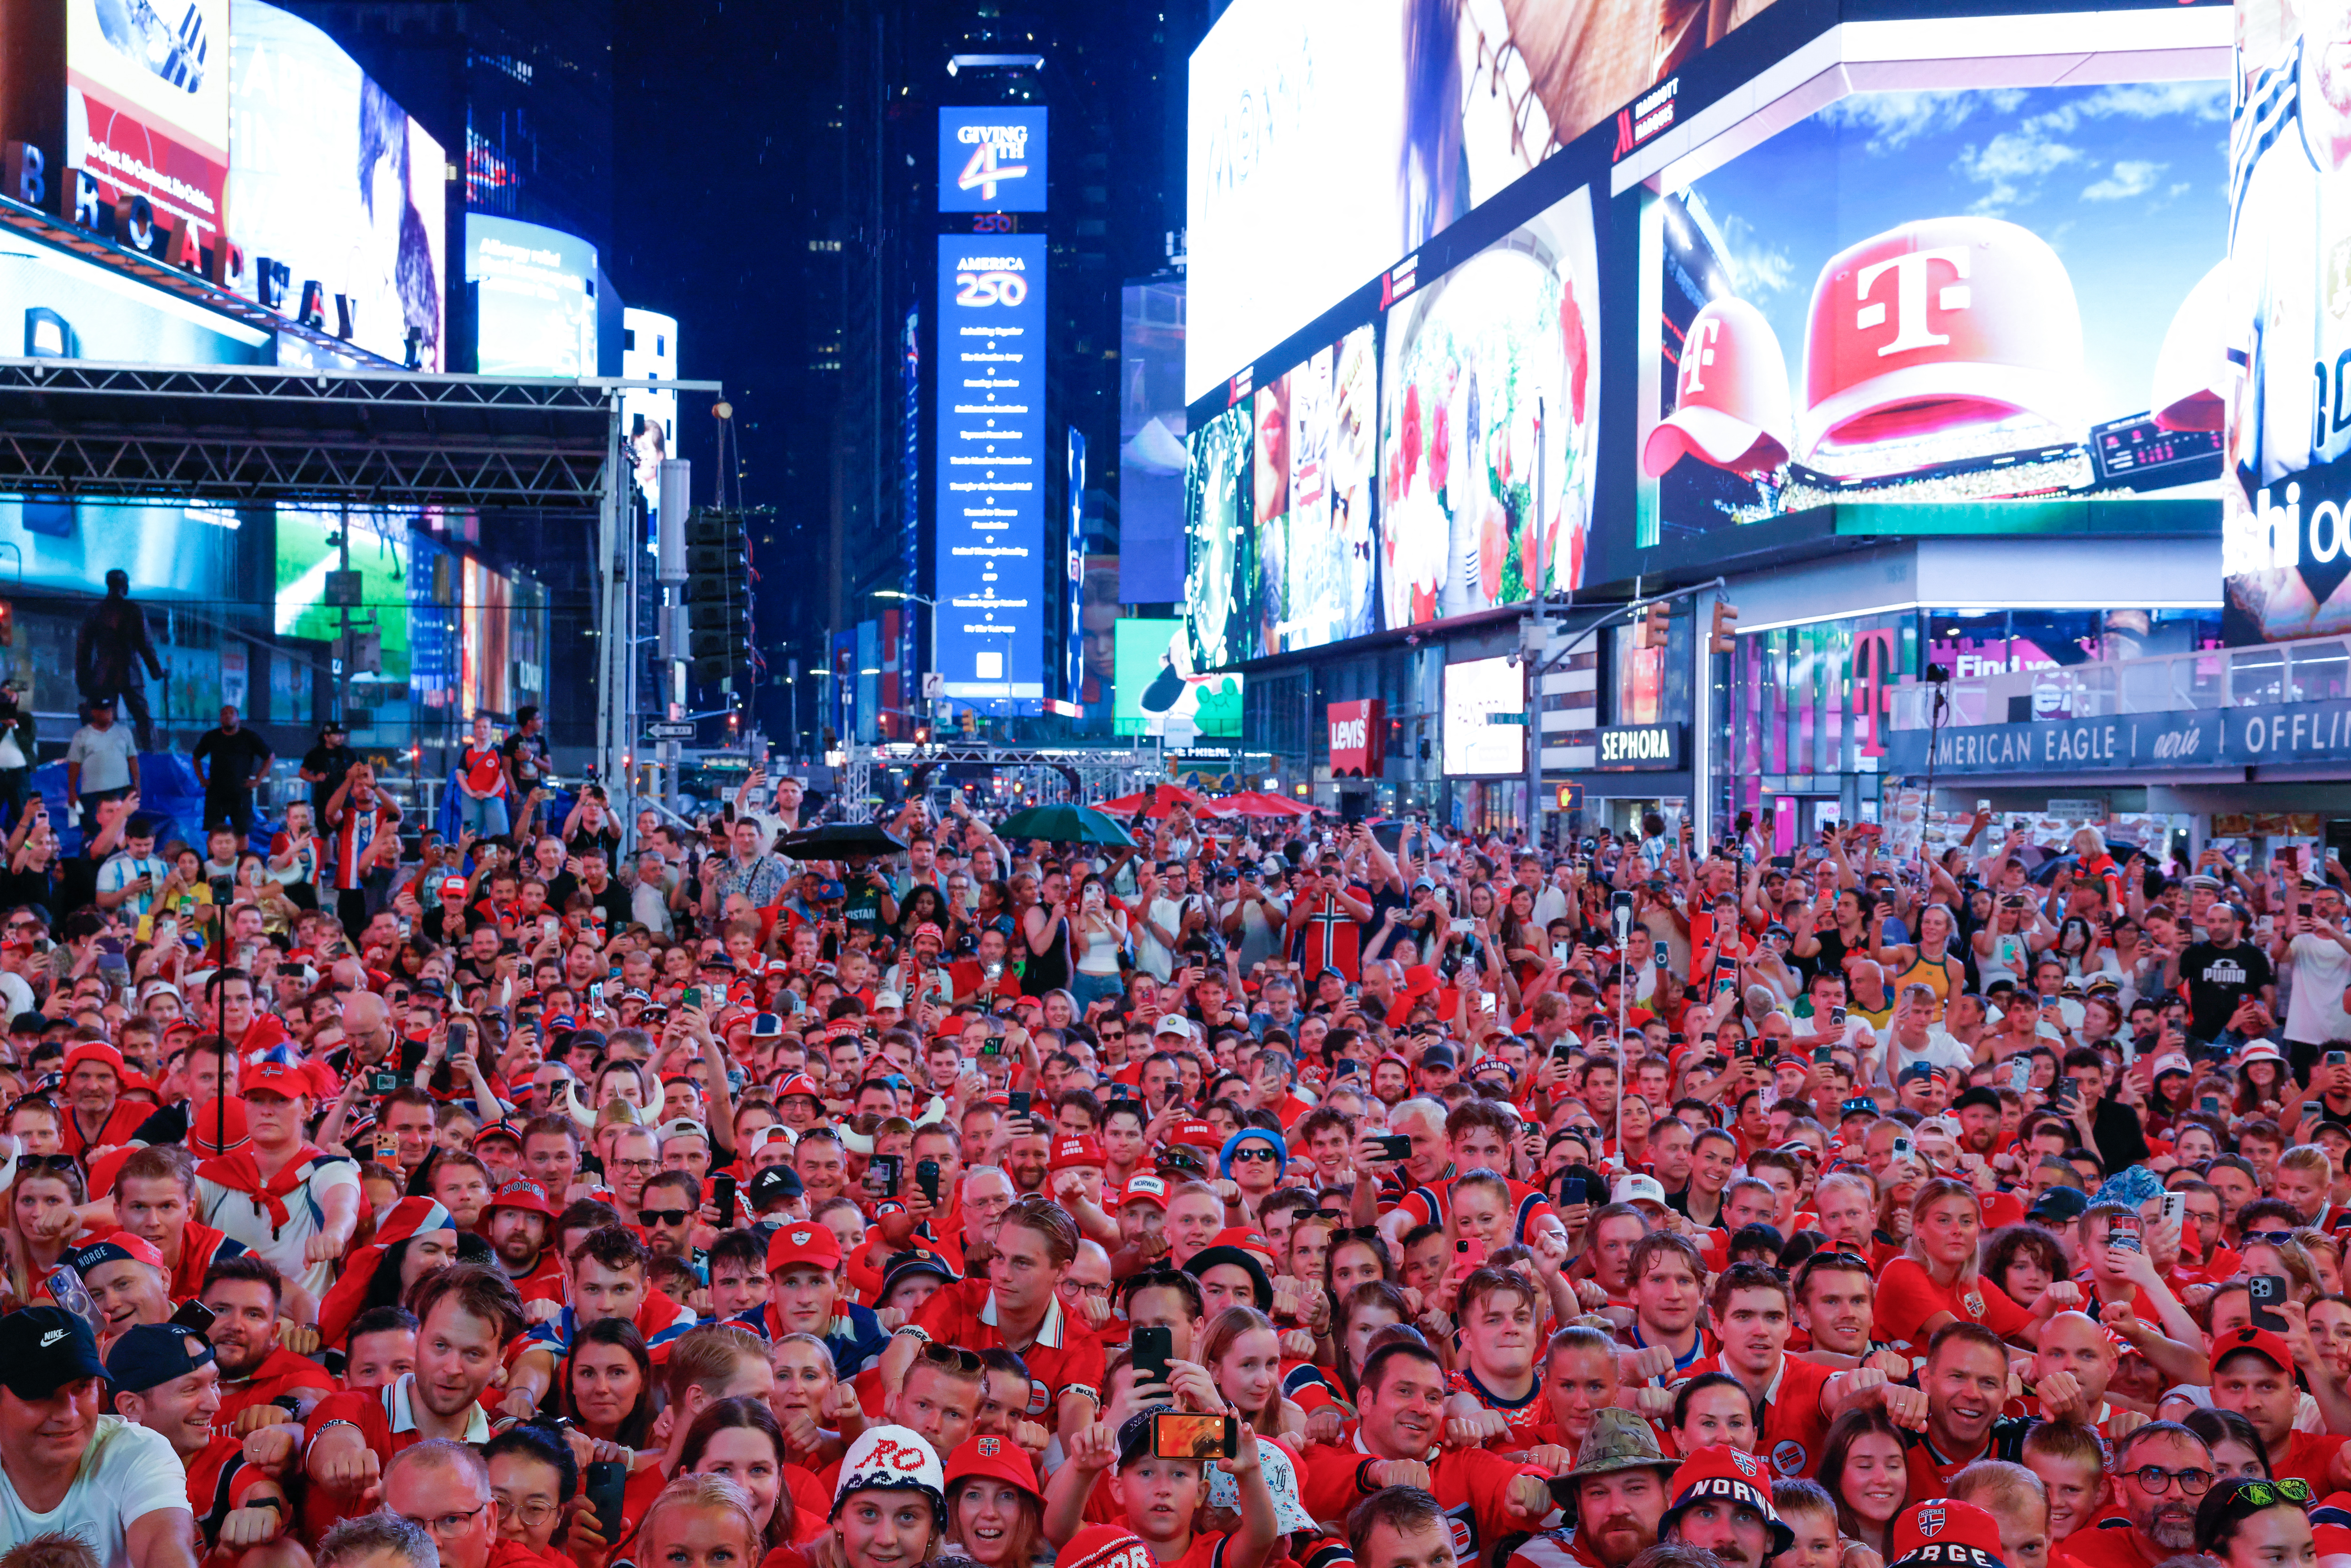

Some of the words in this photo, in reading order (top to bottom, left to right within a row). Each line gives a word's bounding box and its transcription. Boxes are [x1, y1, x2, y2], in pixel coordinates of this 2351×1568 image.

[1635, 77, 1679, 120] MARRIOTT
[1635, 104, 1673, 141] MARQUIS
[957, 126, 1028, 144] GIVING
[956, 258, 1026, 271] AMERICA
[956, 271, 1027, 307] 250
[1956, 654, 2021, 678] Find
[1602, 728, 1670, 761] SEPHORA
[1925, 732, 2032, 766] AMERICAN
[2045, 726, 2115, 762] EAGLE
[2153, 719, 2200, 759] aerie
[2202, 968, 2247, 984] PUMA
[502, 1181, 545, 1201] NORGE
[1134, 1180, 1159, 1190] NORWAY
[78, 1245, 108, 1268] NORGE
[44, 1328, 63, 1341] NIKE
[896, 1328, 928, 1343] NORGE
